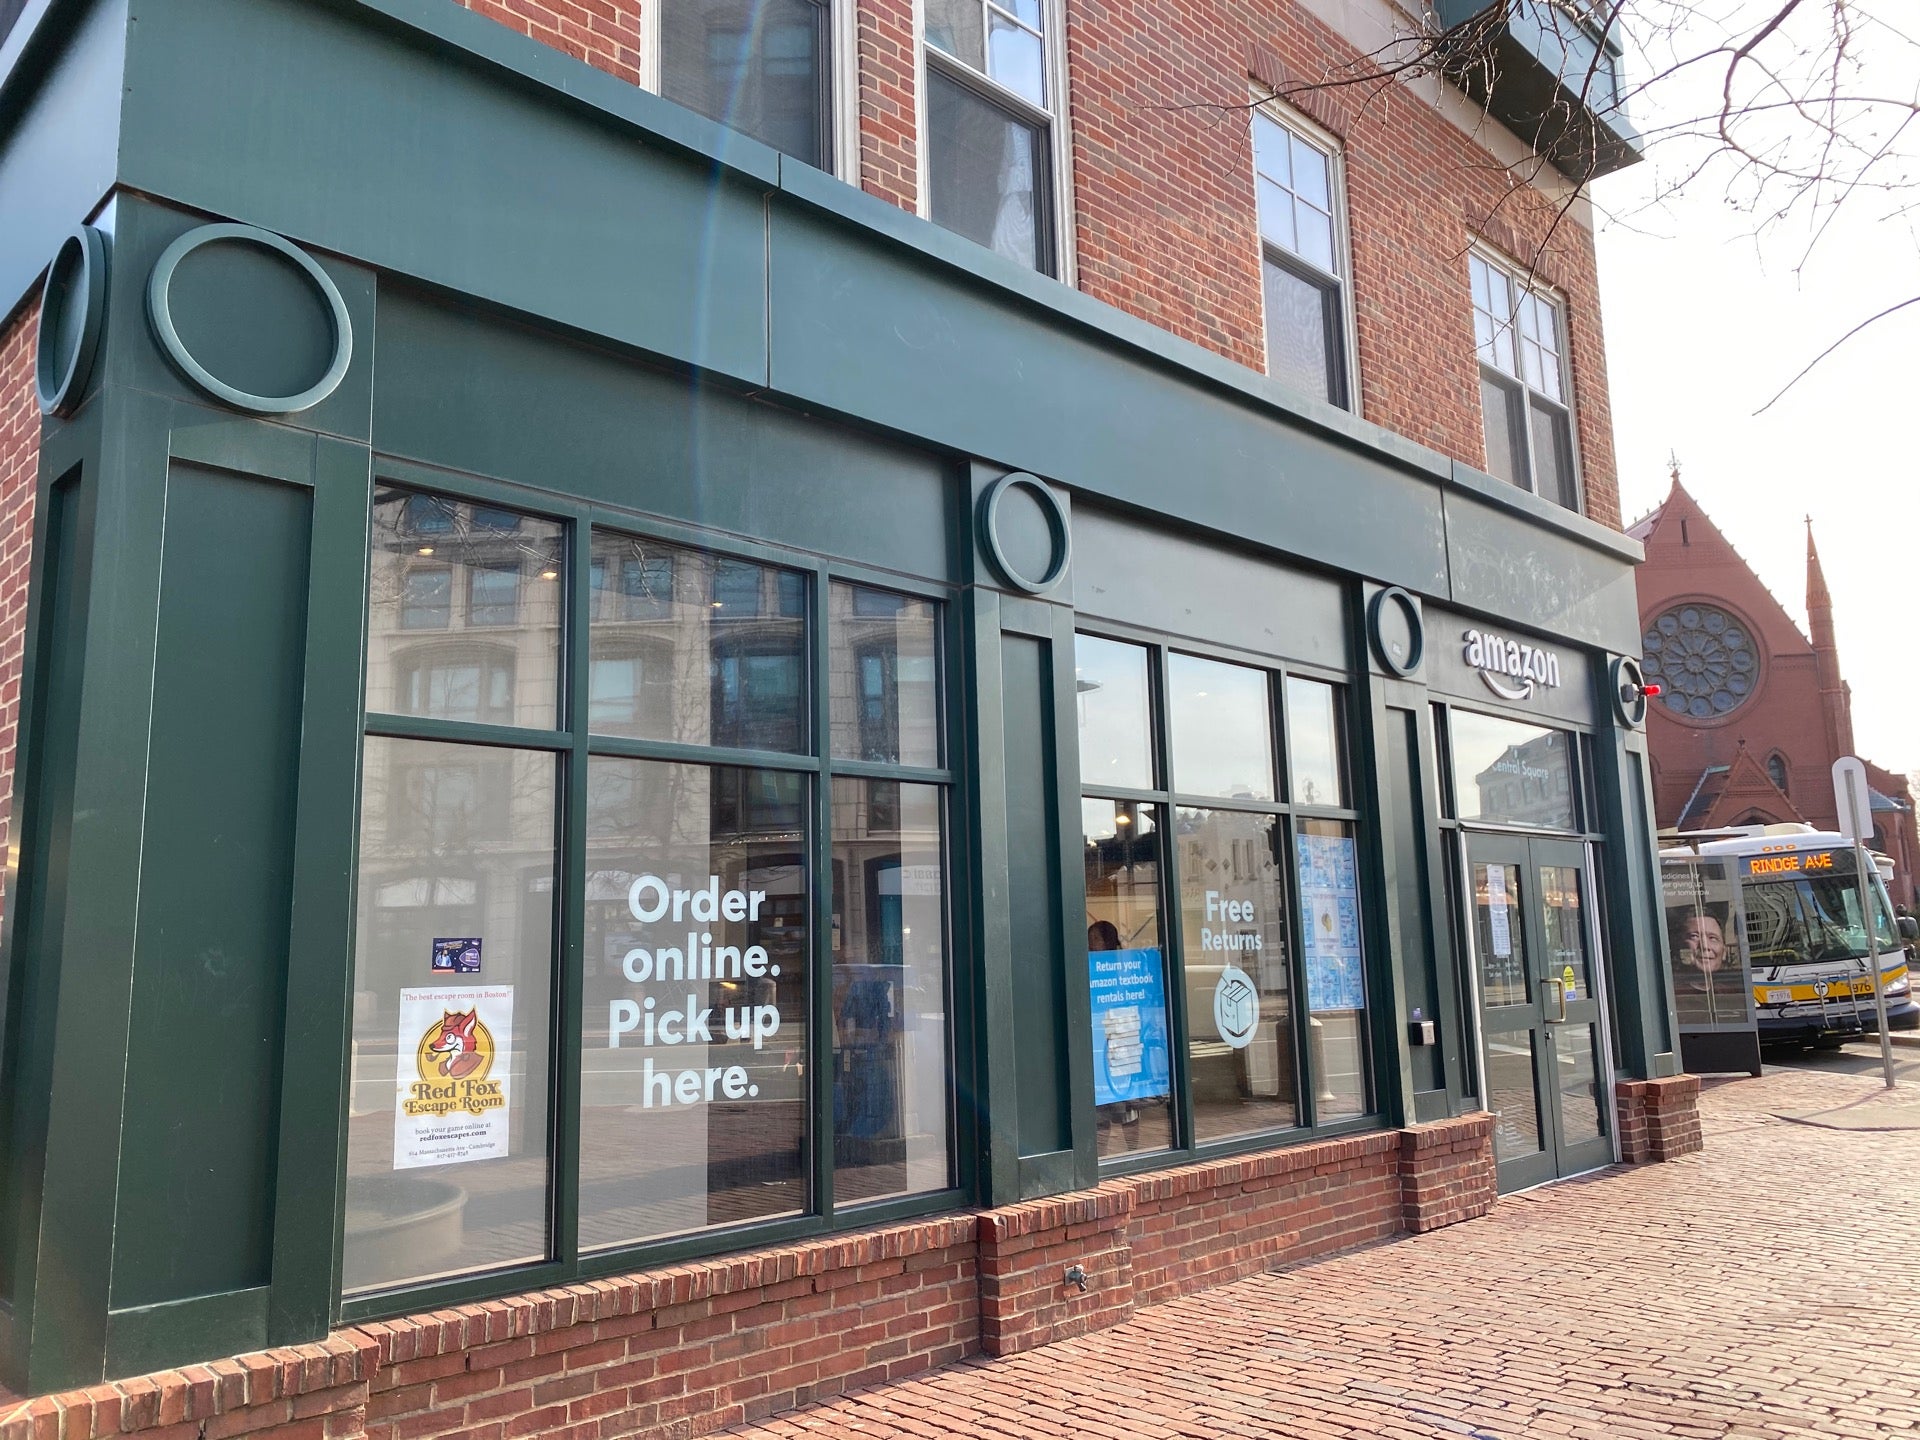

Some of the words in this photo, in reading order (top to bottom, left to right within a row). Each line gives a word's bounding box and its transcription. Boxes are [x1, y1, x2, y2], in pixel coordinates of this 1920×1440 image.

[1464, 629, 1560, 688] amazon
[1521, 760, 1549, 780] Square
[1750, 855, 1800, 874] RINDGE
[1805, 853, 1833, 869] AVE
[1661, 872, 1690, 880] edicines
[628, 875, 766, 923] Order
[1205, 890, 1255, 922] Free
[1201, 927, 1263, 951] Returns
[622, 932, 781, 983] online.
[1096, 960, 1121, 972] Return
[1123, 960, 1141, 972] your
[1119, 973, 1154, 986] textbook
[418, 992, 432, 1001] best
[434, 993, 456, 1001] escape
[457, 991, 475, 999] room
[476, 991, 483, 999] in
[1097, 991, 1124, 1004] rentals
[1125, 989, 1145, 1001] here!
[608, 994, 713, 1048] Pick
[725, 1003, 781, 1050] up
[412, 1081, 456, 1100] Red
[460, 1079, 498, 1097] Fox
[643, 1058, 759, 1108] here.
[405, 1100, 457, 1115] Escape
[459, 1096, 503, 1114] Room
[415, 1127, 430, 1135] book
[430, 1127, 446, 1135] your
[447, 1125, 463, 1133] game
[464, 1122, 484, 1130] online
[419, 1130, 487, 1142] redfoxescapes.com
